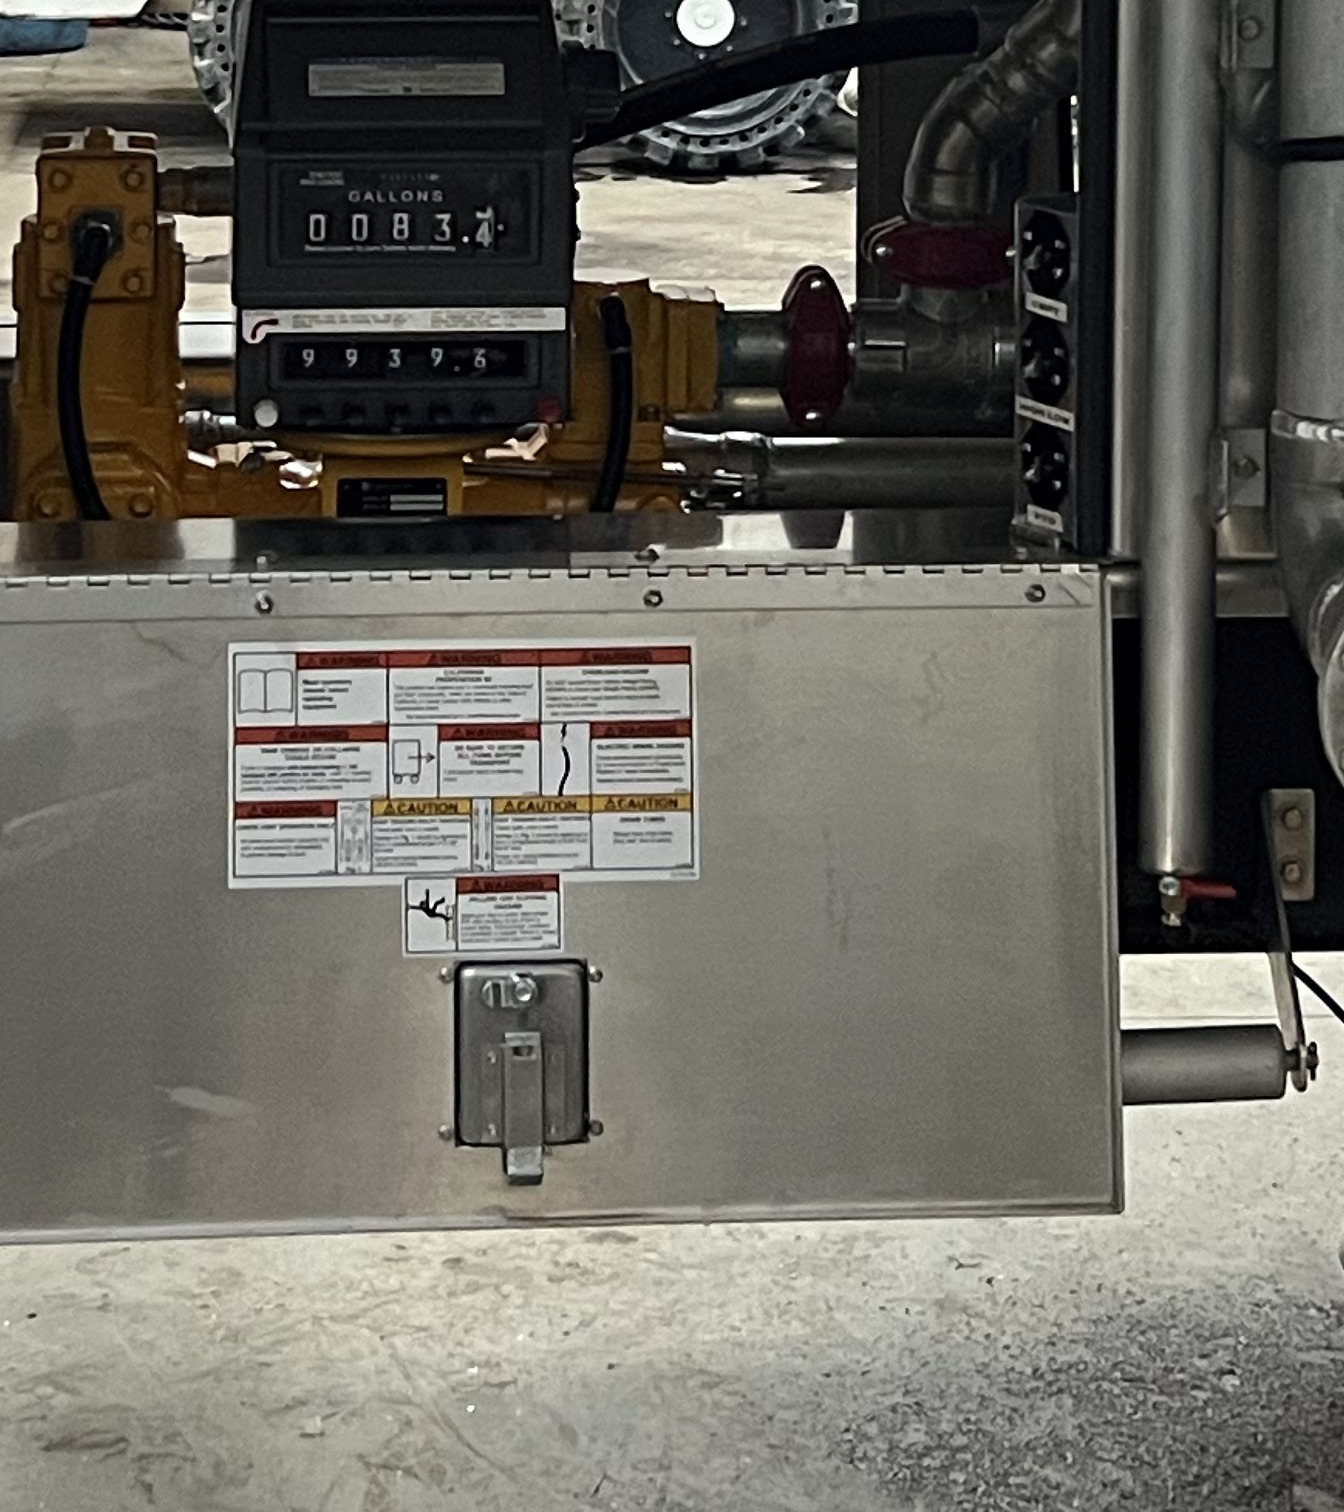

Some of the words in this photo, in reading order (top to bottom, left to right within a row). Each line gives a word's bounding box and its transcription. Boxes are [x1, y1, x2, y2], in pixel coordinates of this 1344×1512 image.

[348, 189, 444, 203] GALLONS
[397, 801, 459, 814] CAUTION
[517, 800, 577, 812] CAUTION
[617, 798, 678, 809] CAUTION
